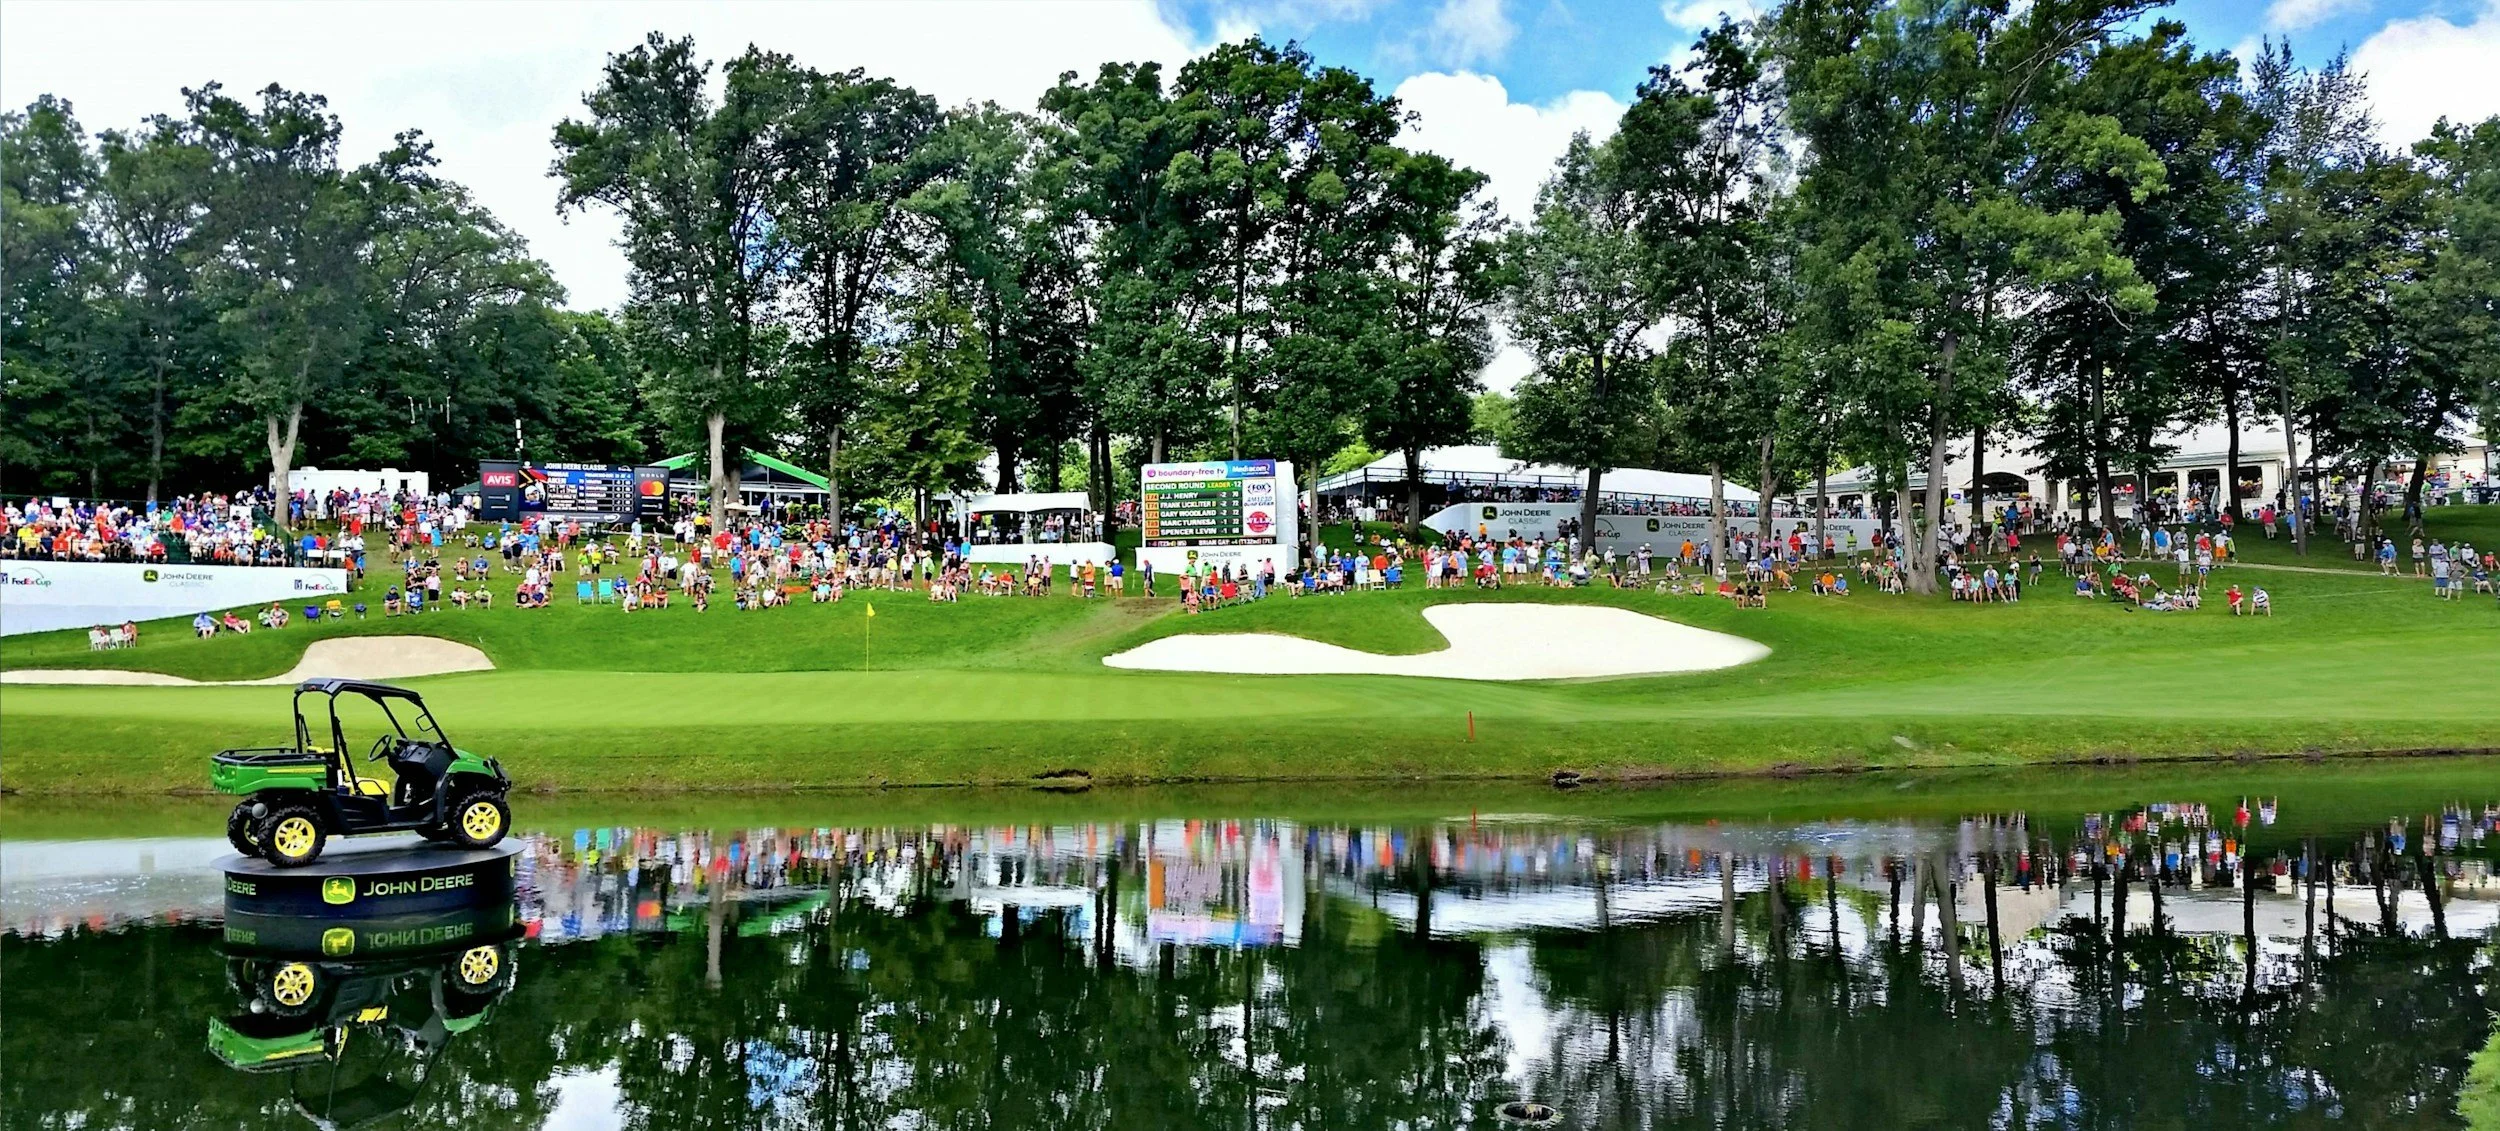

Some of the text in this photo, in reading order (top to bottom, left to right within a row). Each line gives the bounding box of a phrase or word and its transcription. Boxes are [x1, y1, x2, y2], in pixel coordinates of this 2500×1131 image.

[1158, 468, 1214, 477] boundary-free
[487, 475, 512, 485] AVIS
[1178, 481, 1206, 489] ROUND
[1179, 509, 1217, 517] WOODLAND
[1500, 508, 1551, 517] JOHN DEERE
[1830, 523, 1851, 531] DEERE
[161, 572, 213, 580] JOHN DEERE
[12, 577, 51, 587] FedExCup
[227, 875, 257, 896] DEERE
[362, 873, 475, 897] JOHN DEERE
